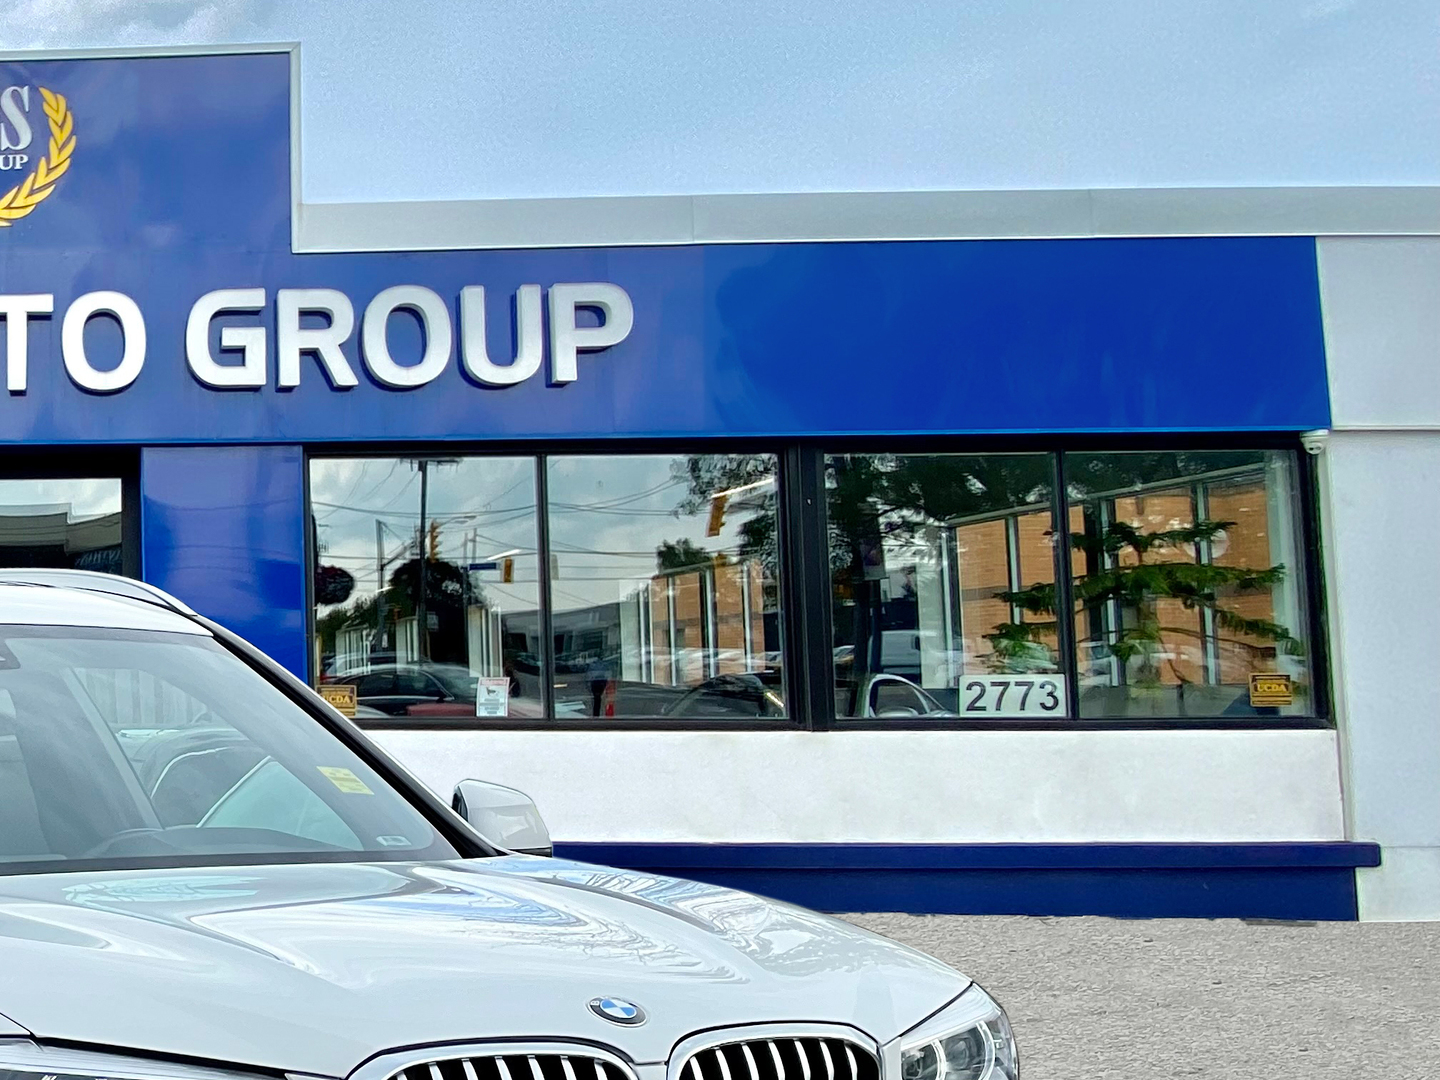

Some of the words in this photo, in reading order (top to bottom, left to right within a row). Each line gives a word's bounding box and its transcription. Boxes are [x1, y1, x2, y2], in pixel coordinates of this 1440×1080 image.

[185, 282, 634, 389] GROUP
[965, 681, 1059, 712] 2773
[1257, 683, 1288, 692] UCDA
